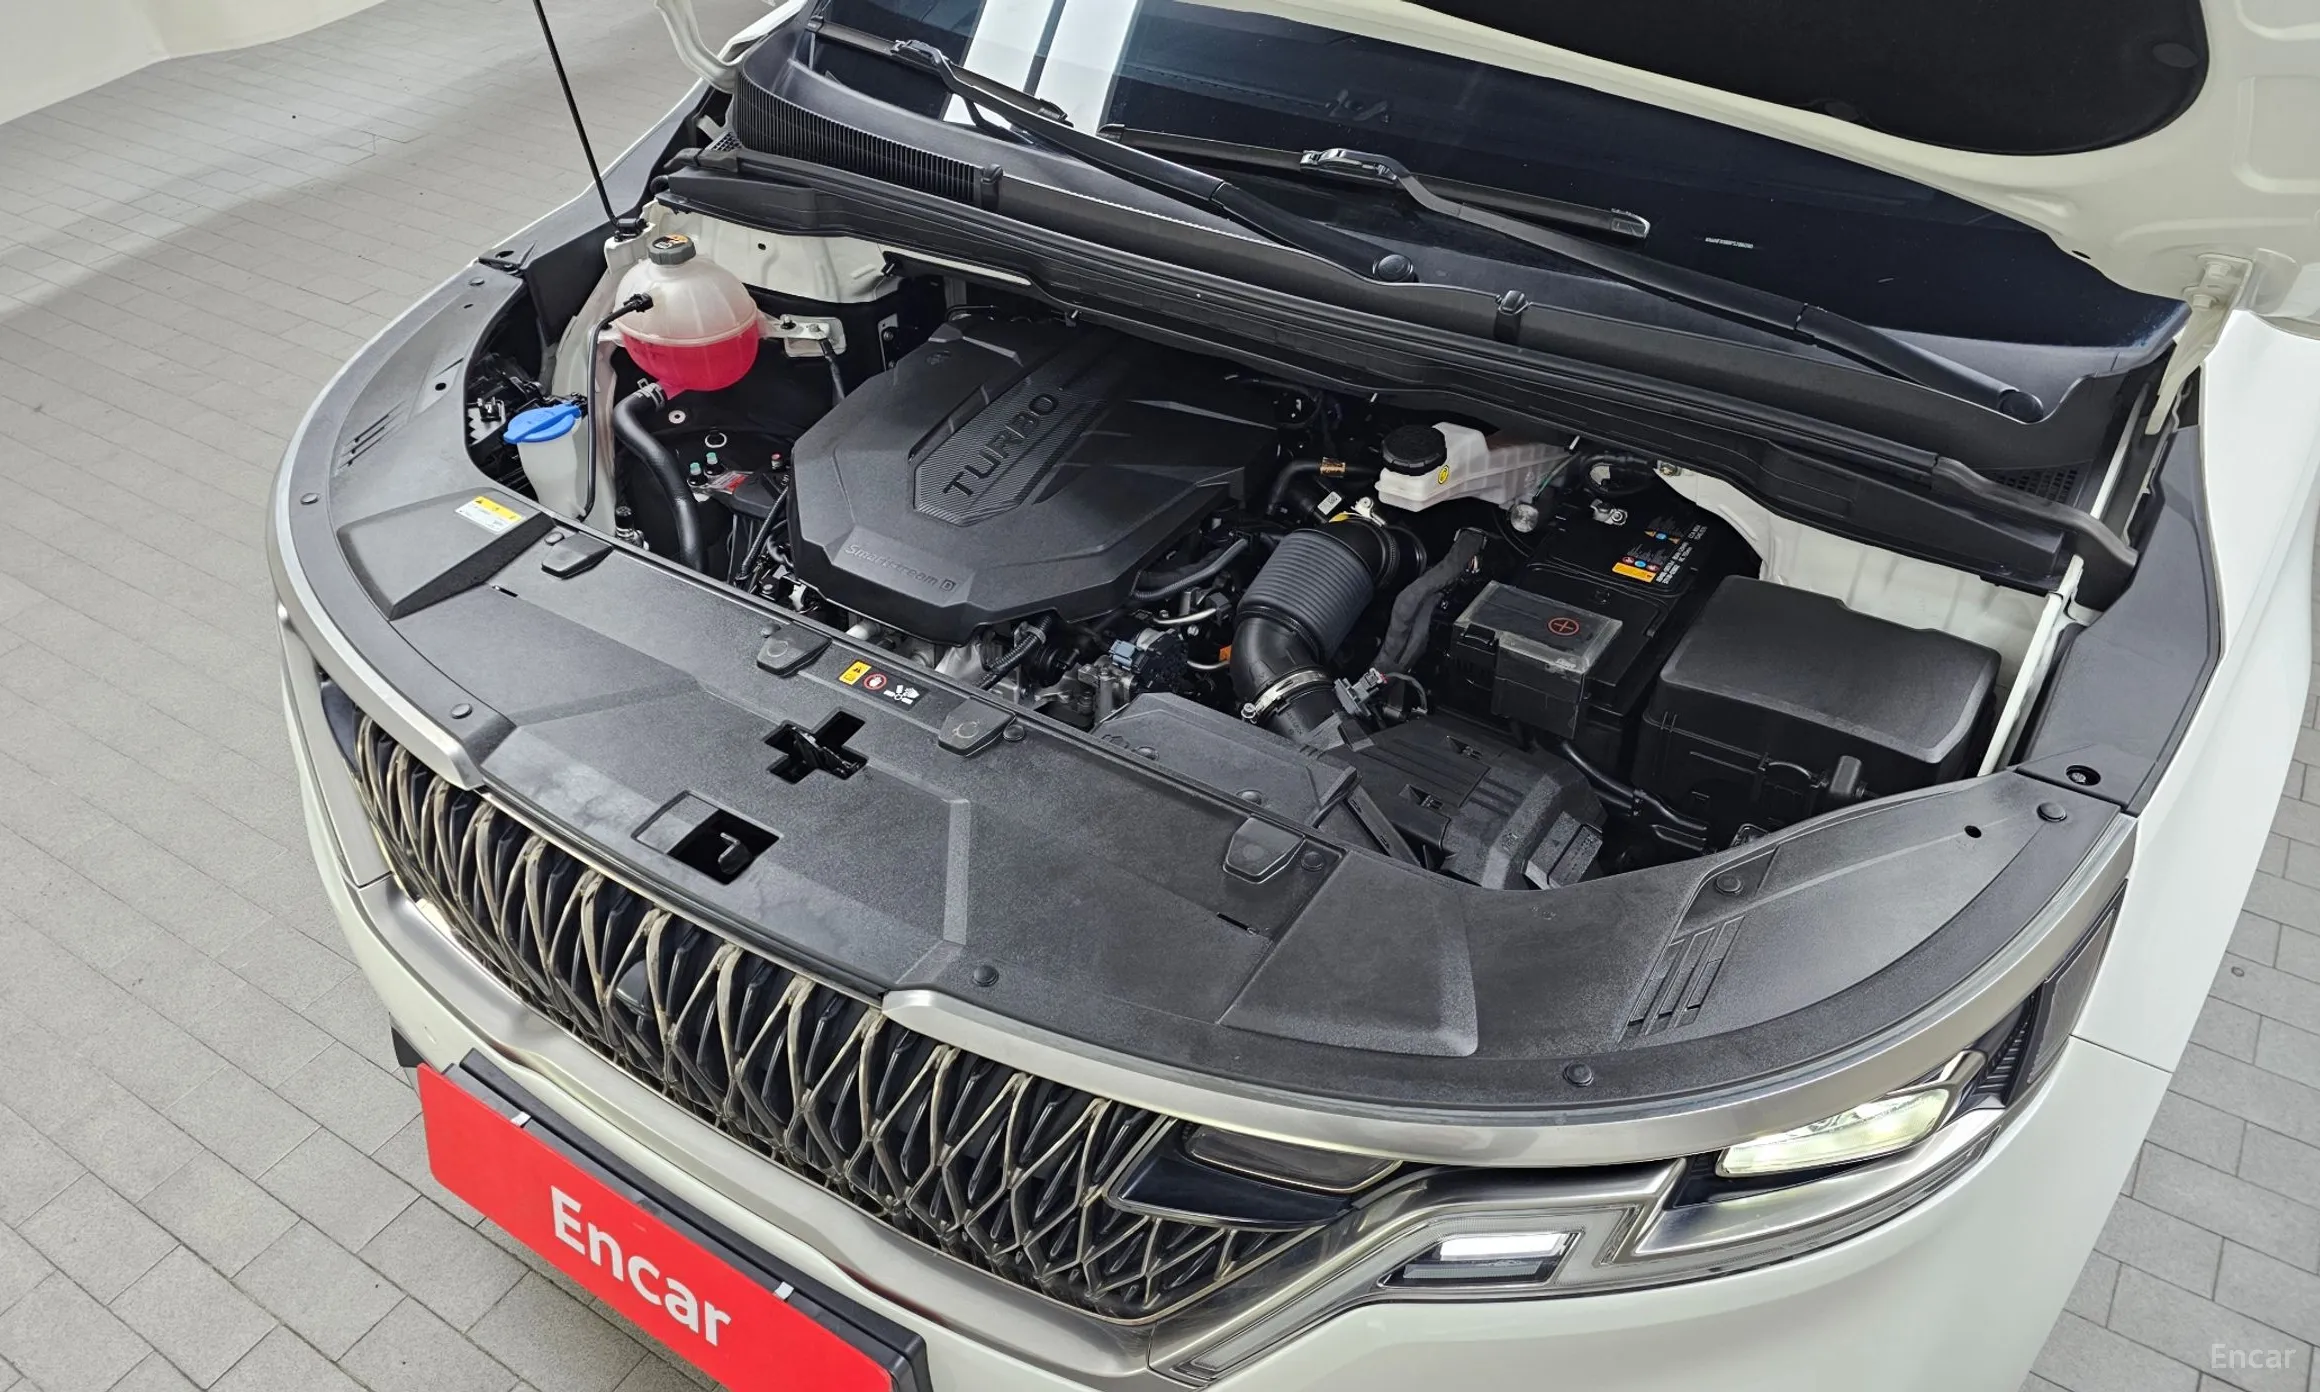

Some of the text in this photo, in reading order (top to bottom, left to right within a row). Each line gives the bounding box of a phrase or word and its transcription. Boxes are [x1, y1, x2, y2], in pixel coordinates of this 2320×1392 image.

[943, 393, 1059, 496] TURBO
[844, 544, 939, 586] Smartstream
[551, 1185, 731, 1346] Encar
